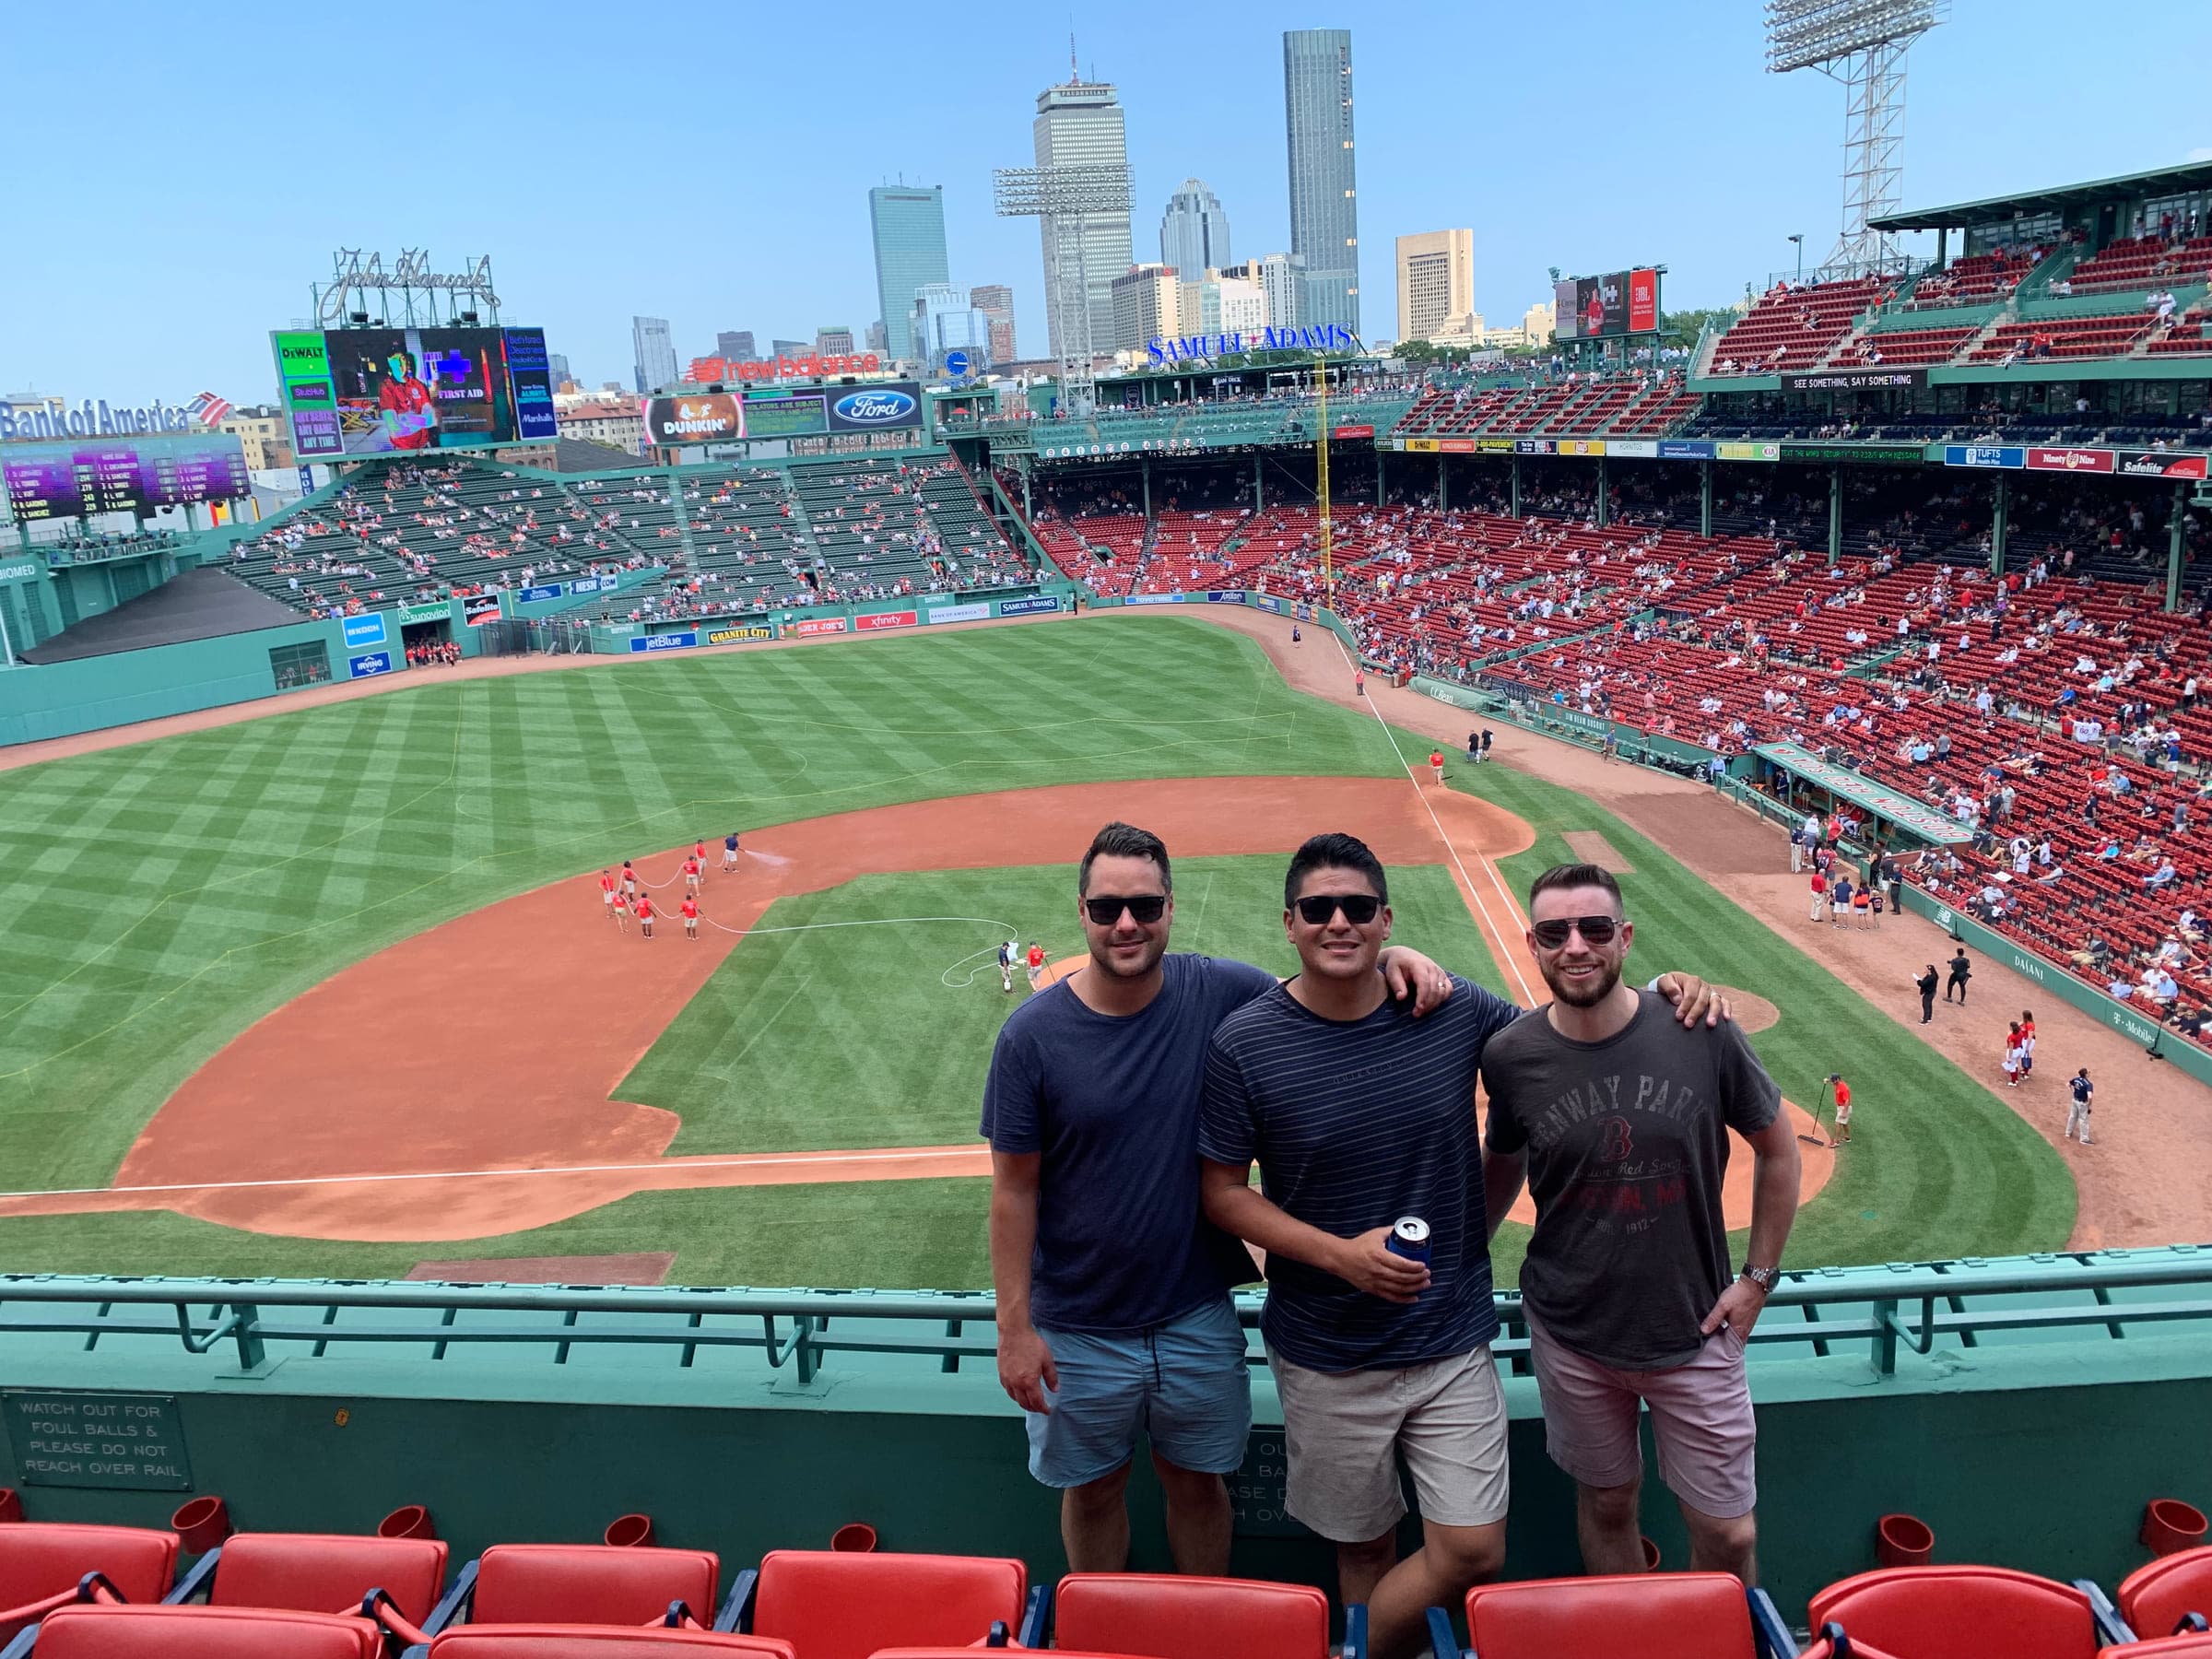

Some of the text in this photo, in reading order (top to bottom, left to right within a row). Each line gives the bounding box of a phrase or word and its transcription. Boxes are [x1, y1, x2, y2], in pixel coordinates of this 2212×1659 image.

[318, 246, 501, 322] John Hancock
[1635, 287, 1650, 301] JBL
[1147, 322, 1352, 368] SAMUEL ADAMS
[727, 362, 777, 380] new
[778, 352, 878, 377] balance
[1794, 375, 1912, 388] SEE SOMETHING, SAY SOMETHING
[295, 388, 325, 396] StubHub
[439, 389, 484, 399] FIRST AID
[851, 395, 900, 418] Ford
[0, 398, 189, 439] Bank of America
[664, 419, 726, 435] DUNKIN'
[303, 437, 318, 449] ANY
[1977, 449, 2001, 458] TUFTS
[2042, 453, 2096, 465] Ninety Nine
[2124, 461, 2163, 474] Safelite
[575, 579, 597, 593] NESN
[465, 603, 499, 615] Safelite
[1002, 598, 1055, 612] SAMUEL ADAMS
[411, 608, 451, 621] sunovion
[871, 615, 901, 627] xfinity
[820, 621, 844, 630] JOE'S
[711, 629, 749, 642] GRANITE
[750, 627, 771, 638] CITY
[646, 636, 682, 649] jetBlue
[358, 659, 383, 670] IRVING
[1618, 1161, 1643, 1175] Red
[1626, 1218, 1650, 1235] 1912
[18, 1403, 161, 1418] WATCH OUT FOR
[31, 1422, 158, 1438] FOUL BALLS &
[29, 1441, 168, 1457] PLEASE DO NOT
[25, 1459, 182, 1477] REACH OVER RAIL
